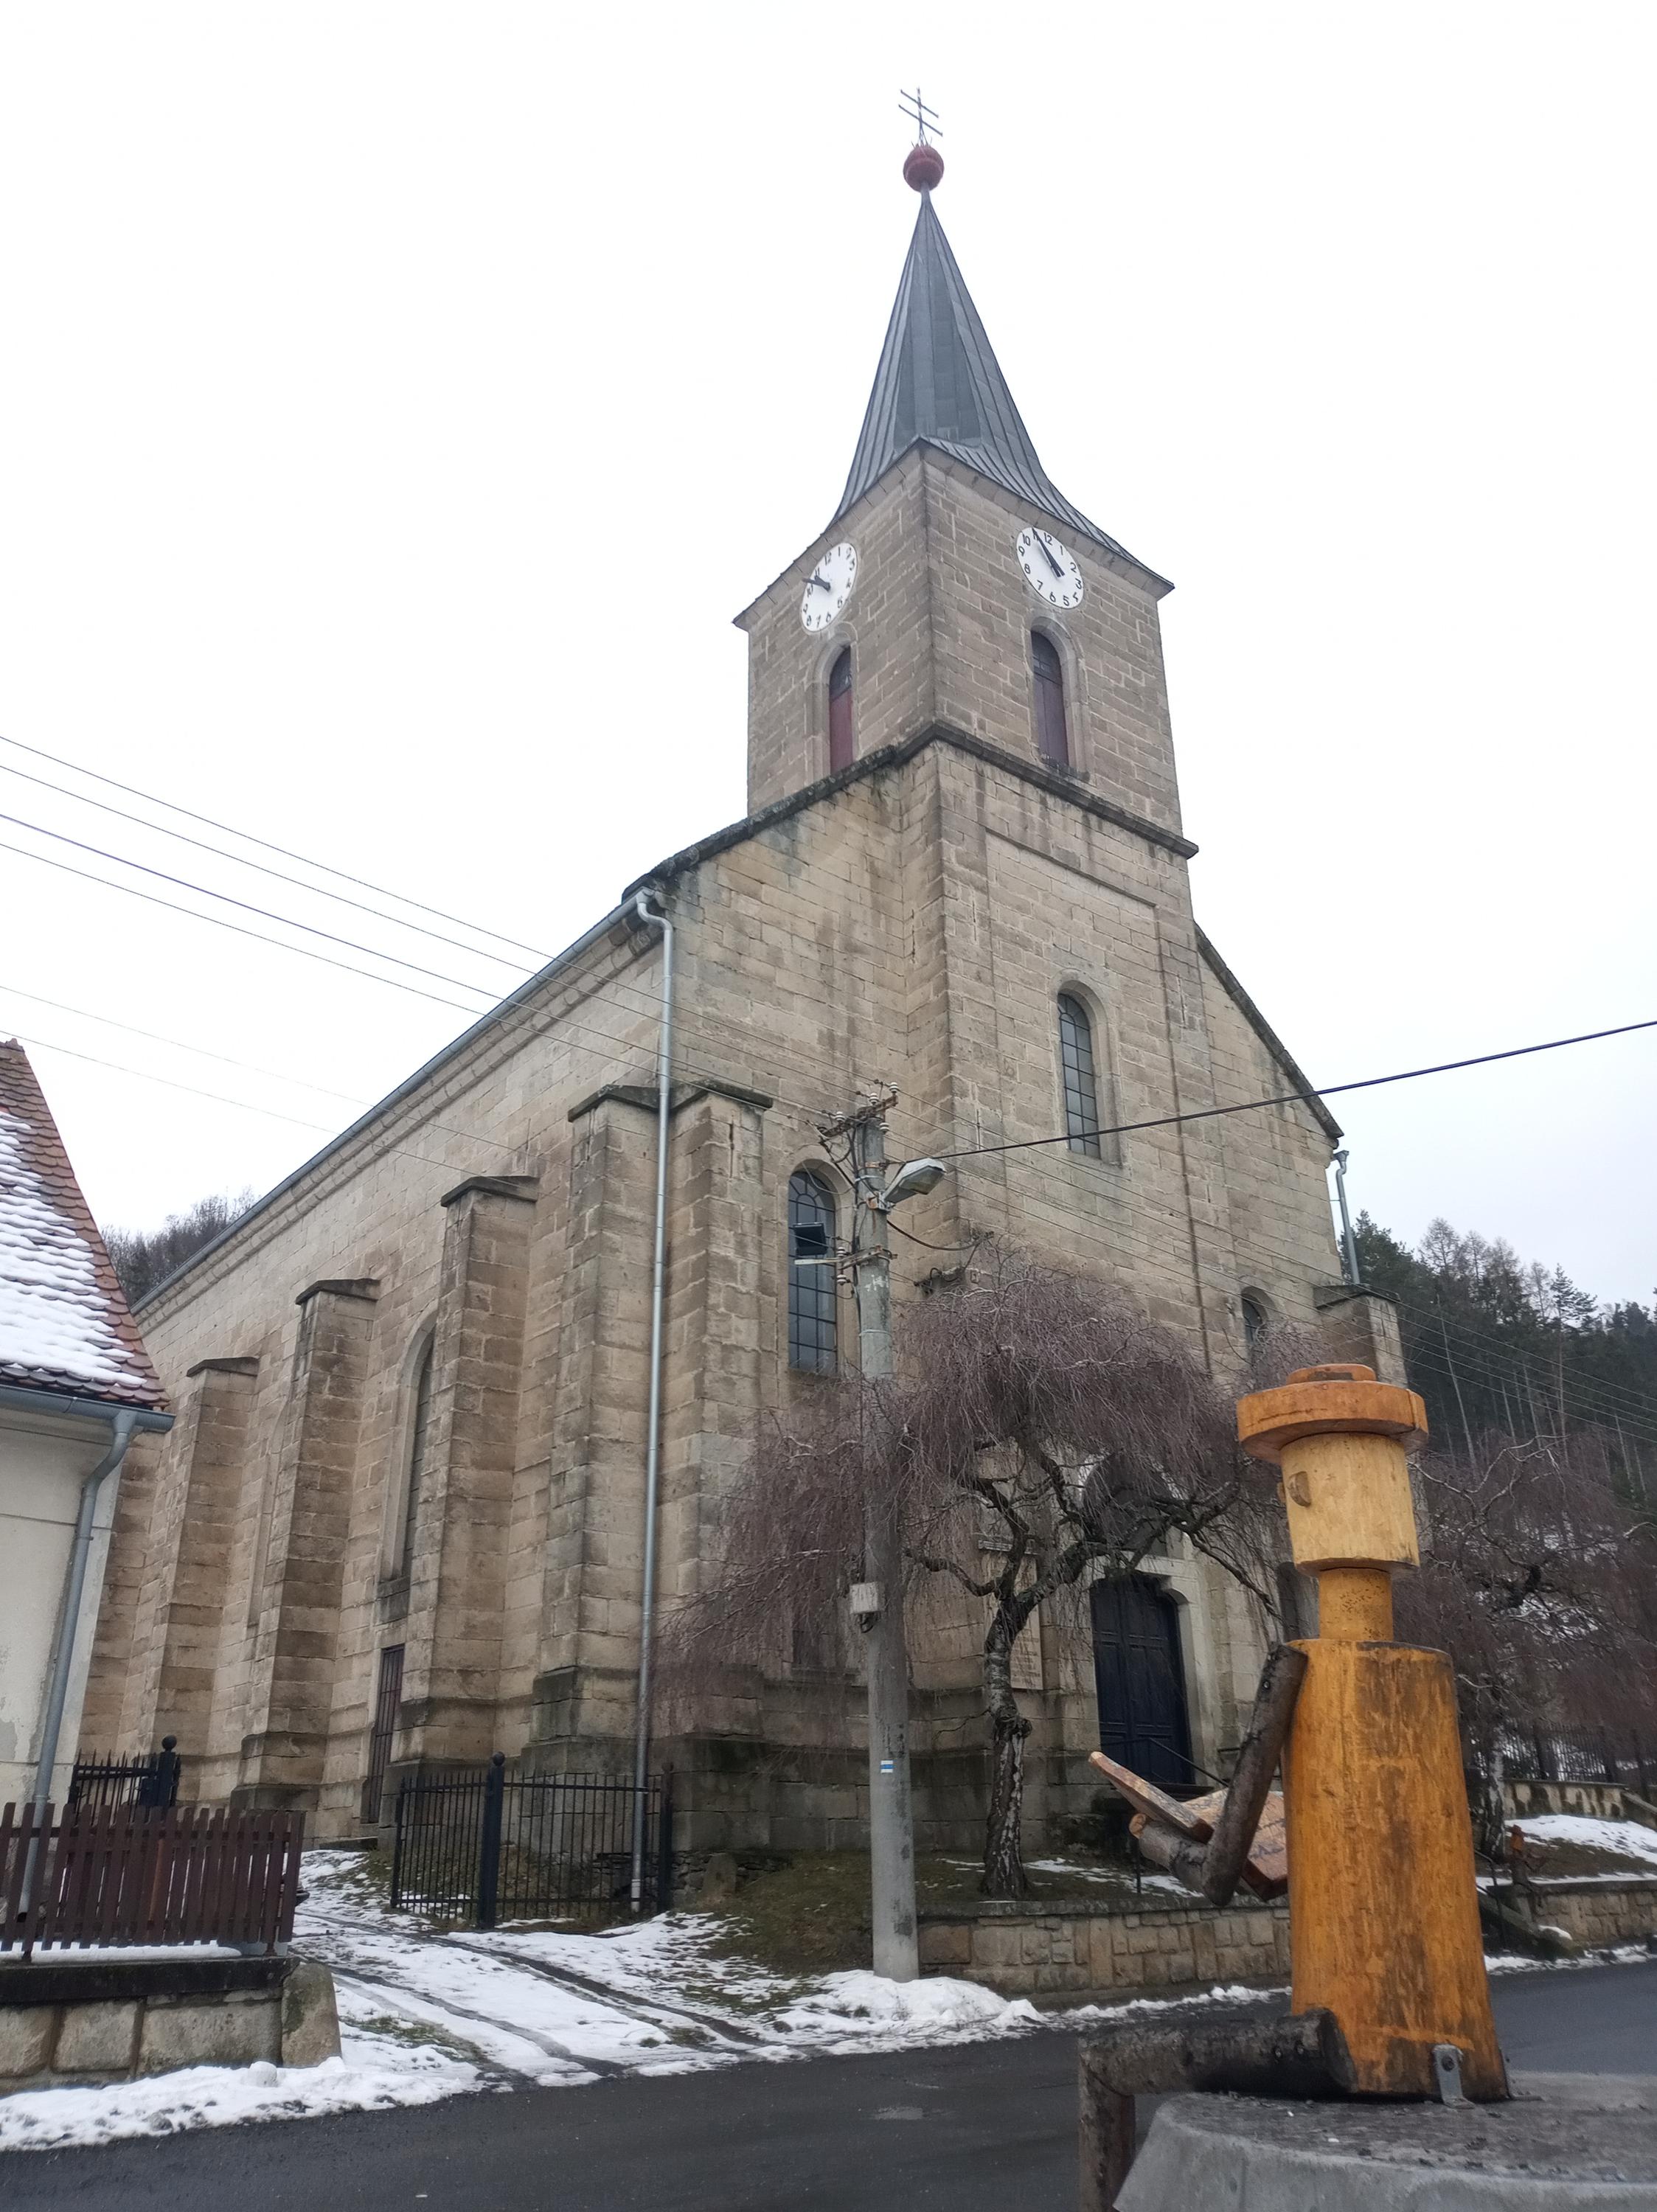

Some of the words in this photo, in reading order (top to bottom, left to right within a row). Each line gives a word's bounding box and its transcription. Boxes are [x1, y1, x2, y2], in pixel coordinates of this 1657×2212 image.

[1022, 533, 1031, 546] 10
[1044, 532, 1053, 546] 12
[1018, 546, 1025, 557] 9
[1060, 546, 1063, 555] 1
[1024, 563, 1031, 574] 8
[1070, 562, 1077, 573] 2
[1037, 580, 1043, 590] 7
[1075, 578, 1082, 590] 3
[1049, 591, 1056, 602] 6
[1063, 595, 1070, 606] 5
